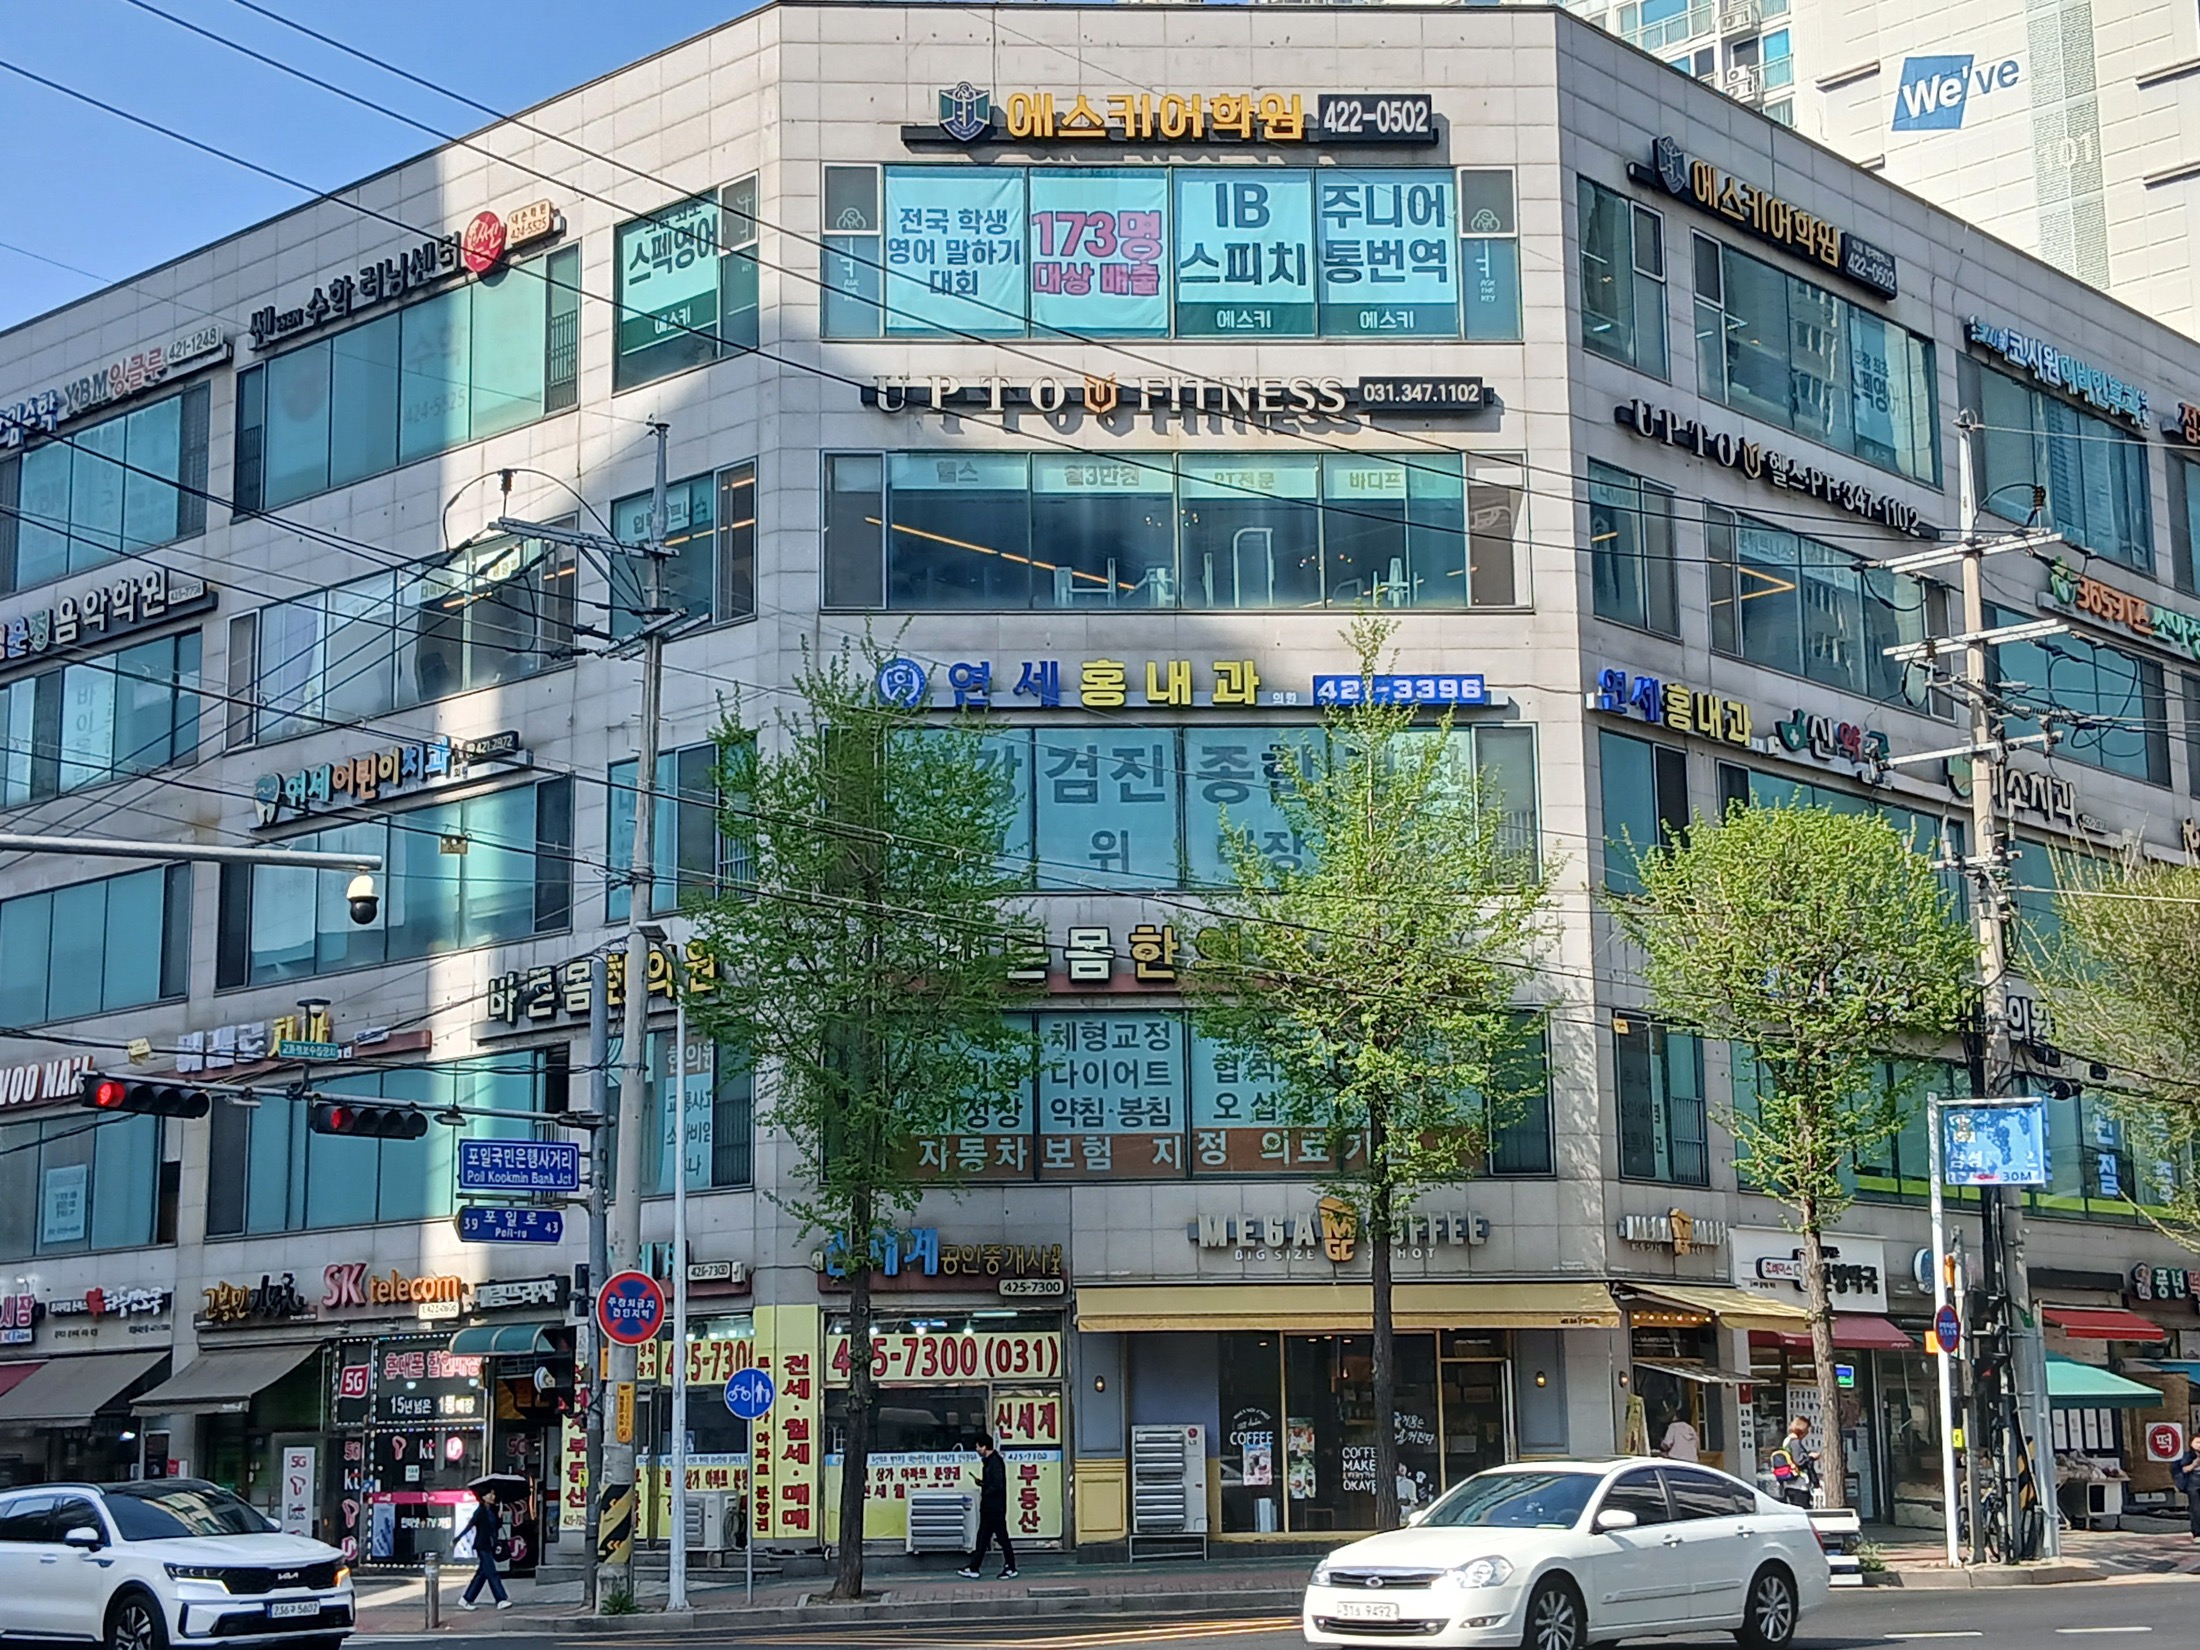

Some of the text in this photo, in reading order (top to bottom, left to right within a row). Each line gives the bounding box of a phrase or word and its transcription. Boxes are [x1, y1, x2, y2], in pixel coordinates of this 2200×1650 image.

[1902, 60, 2019, 118] We've
[1006, 92, 1430, 141] 에스키어학원 422-0502
[900, 208, 1008, 235] 전국 학생
[1216, 182, 1271, 229] IB
[1322, 184, 1446, 229] 주니어
[1693, 160, 1840, 269] 에스키어학원
[629, 213, 717, 287] 스펙영어
[888, 239, 1022, 267] 영어 말하기
[1032, 210, 1164, 262] 173명
[306, 275, 355, 324] 수학
[359, 231, 462, 299] 러닝센터
[1034, 260, 1161, 297] 대상 배출
[1179, 242, 1307, 287] 스피치
[1323, 239, 1447, 285] 통번역
[1847, 252, 1896, 290] 422-0502
[930, 269, 978, 297] 대회
[655, 307, 690, 335] 에스키
[1217, 310, 1272, 331] 에스키
[1360, 310, 1415, 331] 에스키
[169, 327, 218, 360] 421-1248
[1138, 375, 1346, 413] FITNESS
[1362, 381, 1480, 403] 031.347.1102
[55, 570, 166, 643] 음악학원
[948, 659, 1061, 708] 연세
[1081, 658, 1261, 706] 홍내과
[1317, 679, 1482, 701] 42-3396
[1664, 682, 1752, 747] 홍내과
[1050, 1020, 1172, 1053] 체형교정
[1050, 1059, 1172, 1090] 다이어트
[467, 1146, 572, 1170] 포일국민은행사거리
[917, 1136, 1029, 1173] 자동차
[1042, 1135, 1112, 1172] 보험
[467, 1170, 573, 1185] Poil Kookmin Bank Jct
[463, 1210, 559, 1234] 39 포일로 43
[495, 1228, 528, 1239] Poil-ro
[1198, 1210, 1487, 1248] MEGA FFEE
[940, 1244, 1047, 1276] 공인중개사
[1234, 1249, 1266, 1261] BIG
[1273, 1249, 1316, 1261] SIZE
[1390, 1248, 1436, 1260] HOT
[322, 1262, 461, 1308] SK telecom
[1003, 1281, 1061, 1293] 425-7300
[831, 1336, 1059, 1378] 45-7300(031)
[344, 1371, 363, 1393] 5G
[994, 1401, 1058, 1441] 신세계
[1229, 1430, 1274, 1446] COFFEE
[291, 1455, 307, 1469] 5G
[419, 1439, 436, 1460] kt
[1342, 1446, 1377, 1459] COFFE
[344, 1468, 362, 1491] kt
[1017, 1464, 1041, 1534] 부동산
